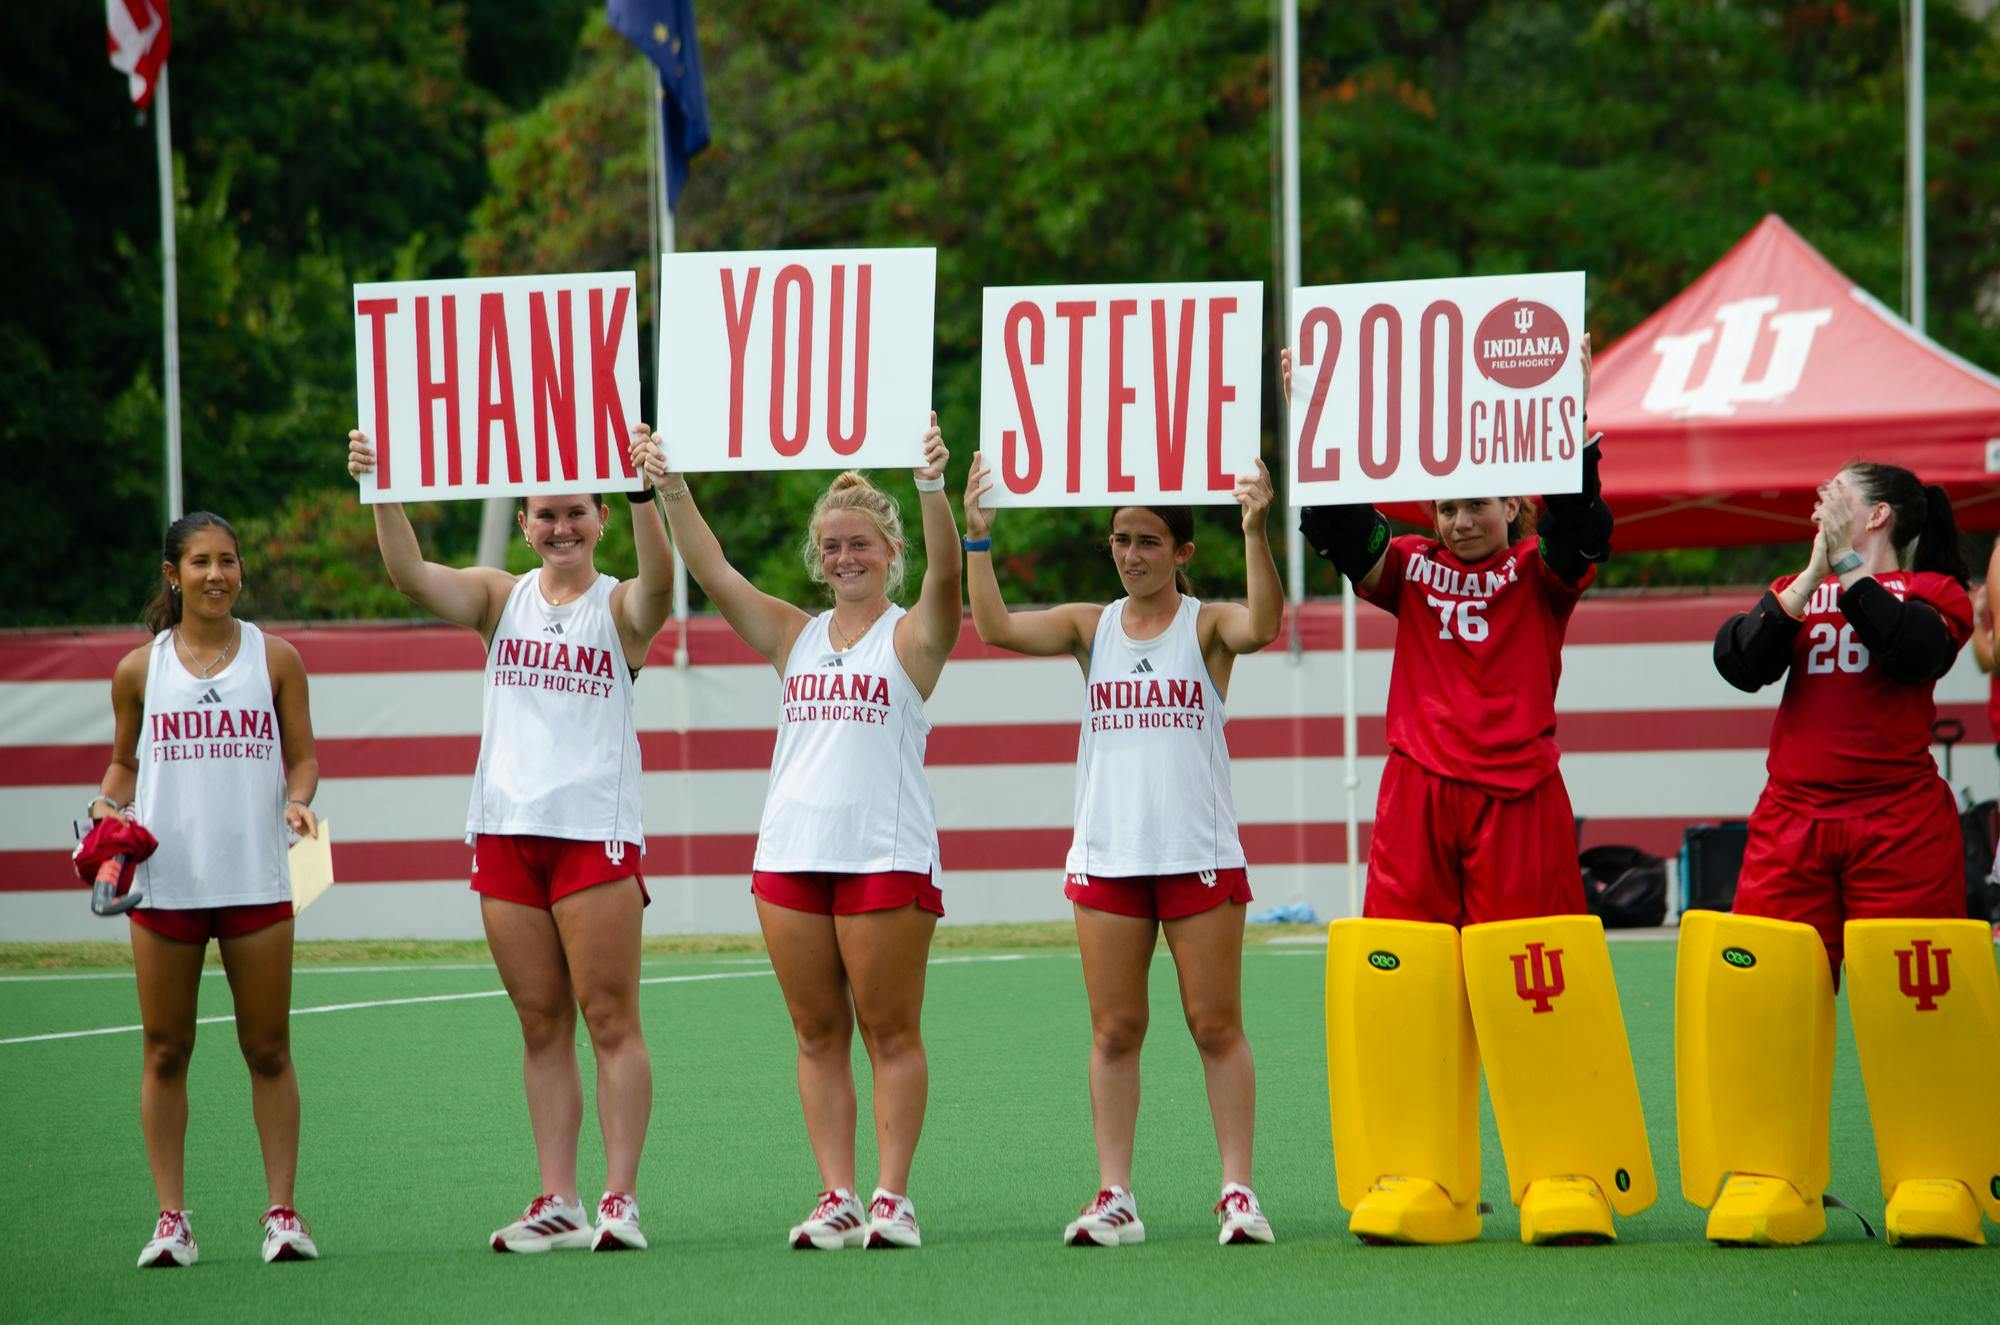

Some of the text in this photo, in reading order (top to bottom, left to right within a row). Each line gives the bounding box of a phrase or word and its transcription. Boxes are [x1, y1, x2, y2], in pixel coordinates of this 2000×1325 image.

[719, 264, 873, 458] YOU
[1483, 336, 1564, 359] INDIANA
[1491, 358, 1556, 369] FIELD HOCKEY
[357, 287, 638, 490] THANK
[1002, 297, 1238, 495] STEVE
[1298, 299, 1464, 484] 200
[1470, 395, 1576, 465] GAMES
[1427, 594, 1489, 642] 76
[497, 638, 615, 680] INDIANA
[1807, 622, 1870, 675] 26
[494, 670, 613, 699] FIELD HOCKEY
[1090, 679, 1205, 712] INDIANA
[151, 709, 274, 742] INDIANA
[821, 705, 888, 725] HOCKEY
[1138, 712, 1205, 731] HOCKEY
[153, 743, 273, 763] FIELD HOCKEY
